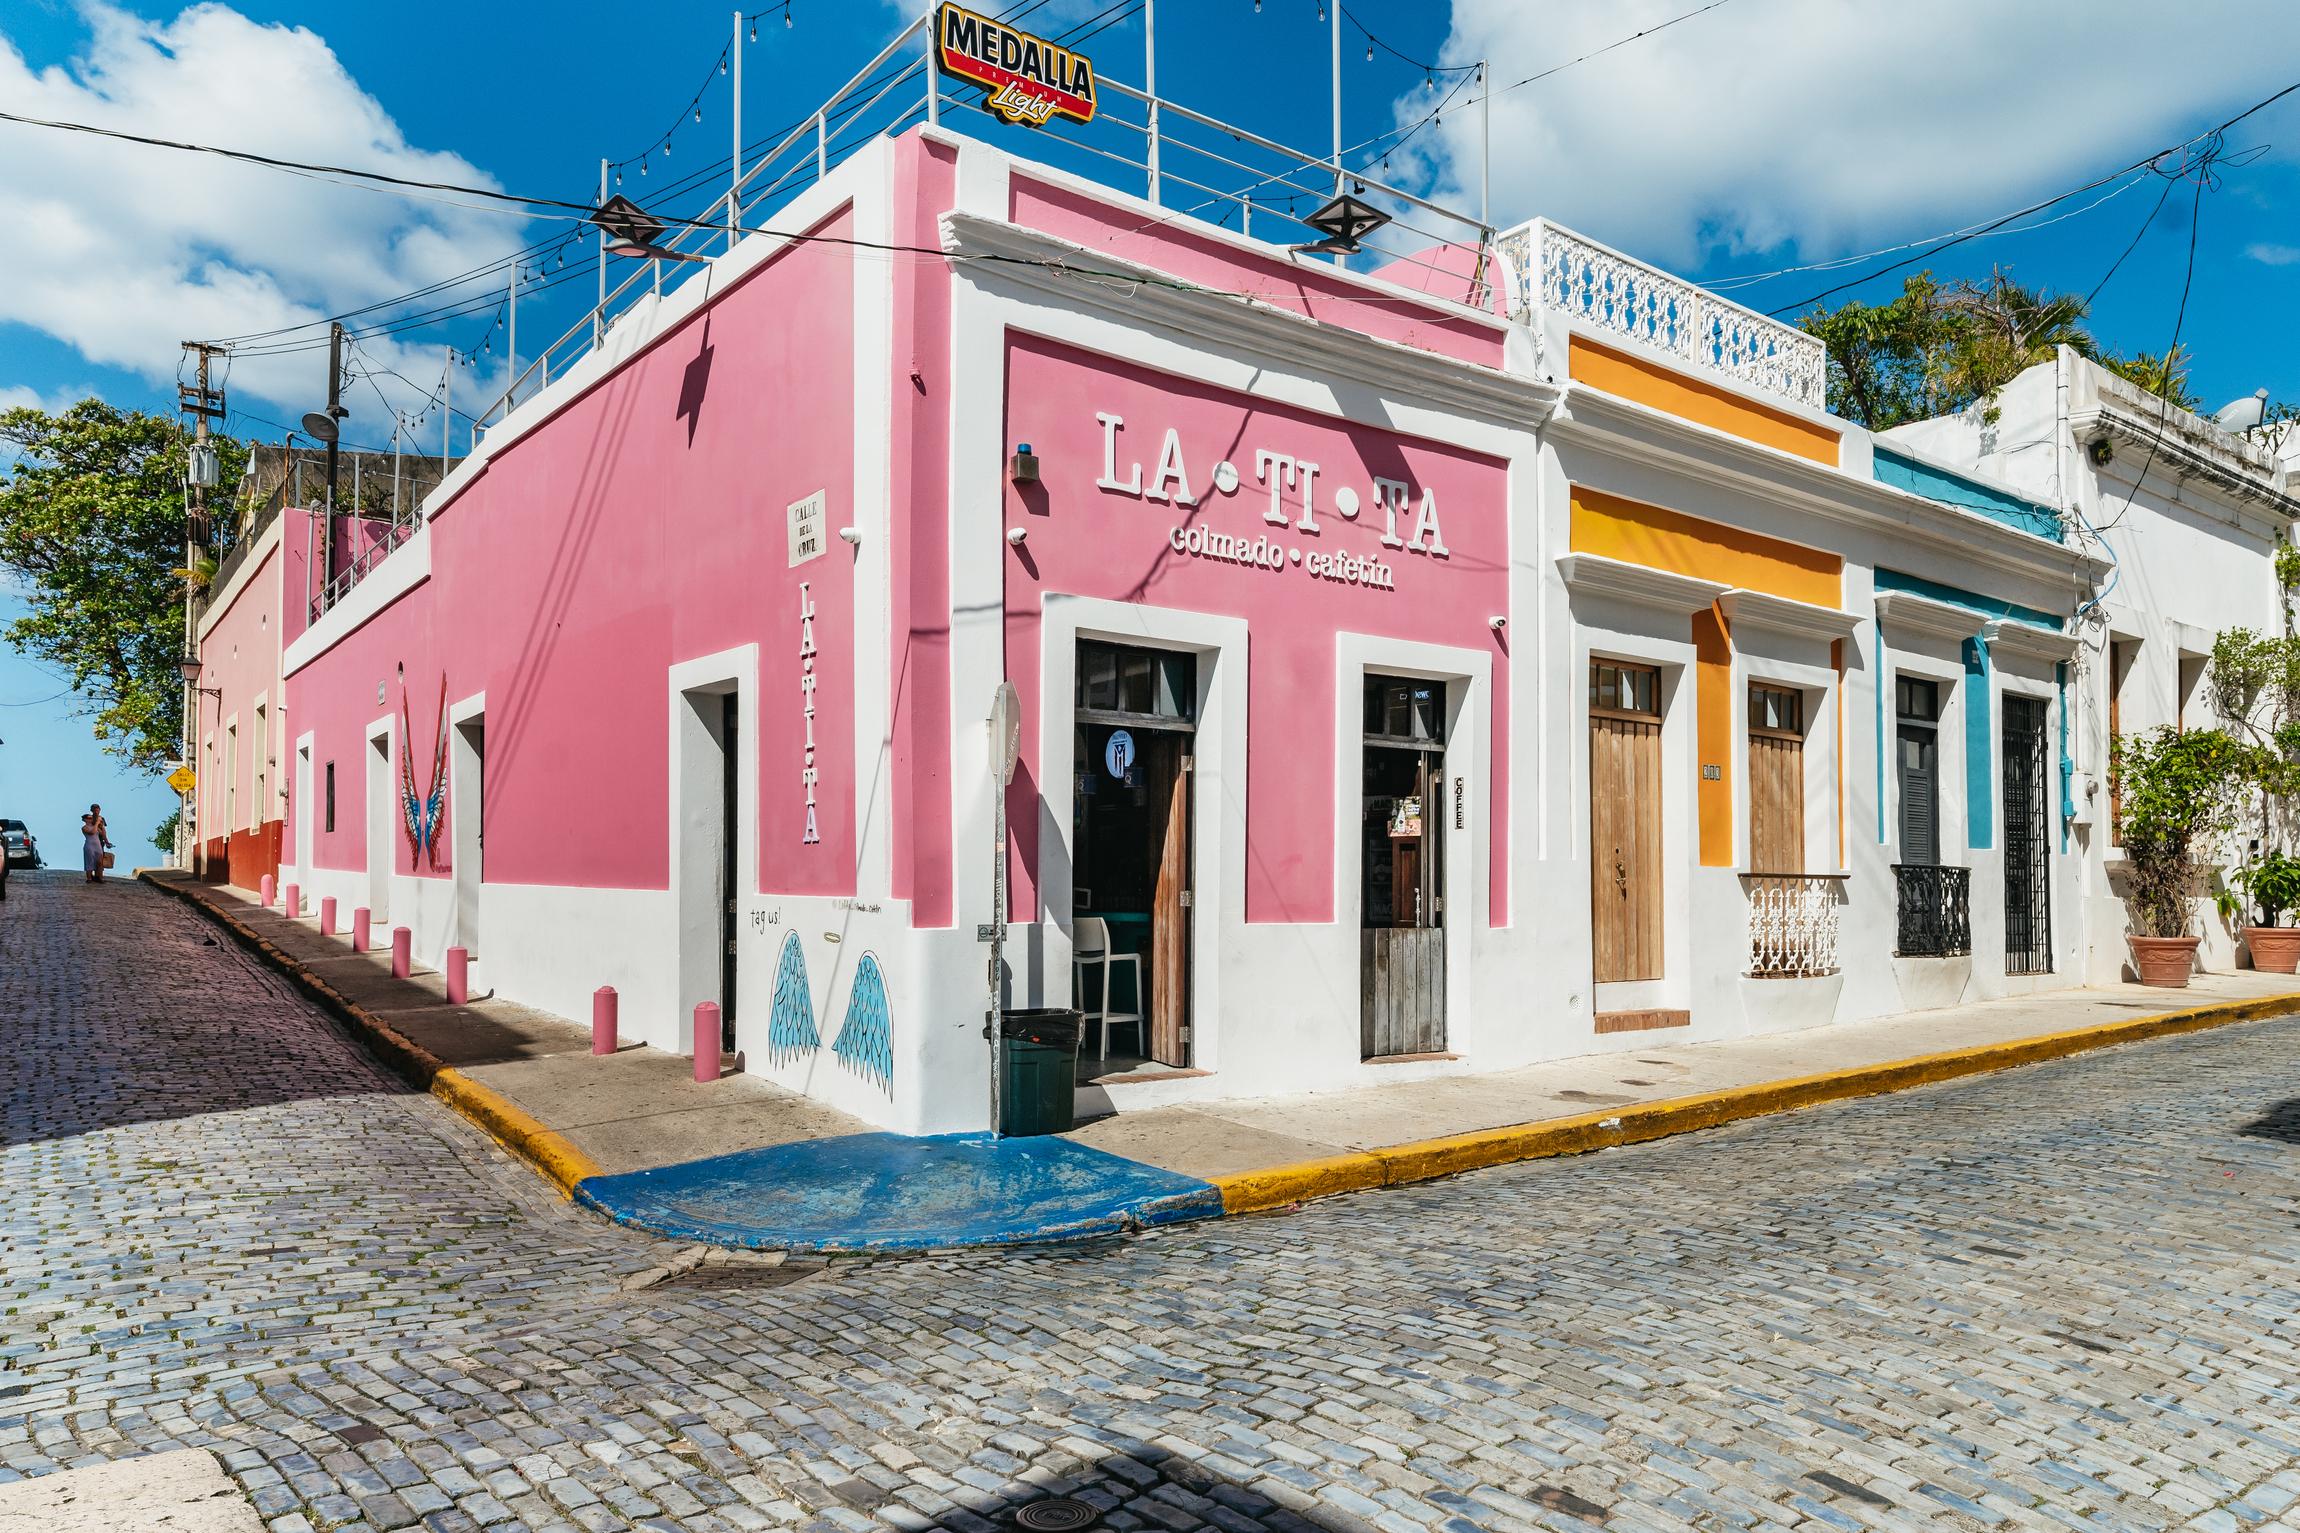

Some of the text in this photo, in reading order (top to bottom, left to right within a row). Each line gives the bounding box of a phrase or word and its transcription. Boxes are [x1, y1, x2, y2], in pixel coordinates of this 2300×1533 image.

[945, 7, 1093, 104] MEDALLA
[978, 66, 1063, 104] PREMIUM
[993, 80, 1059, 120] Light
[795, 501, 817, 523] CALLE
[798, 538, 816, 557] CRUZ
[1170, 524, 1394, 587] colmado cafetín
[750, 905, 781, 935] tag us!
